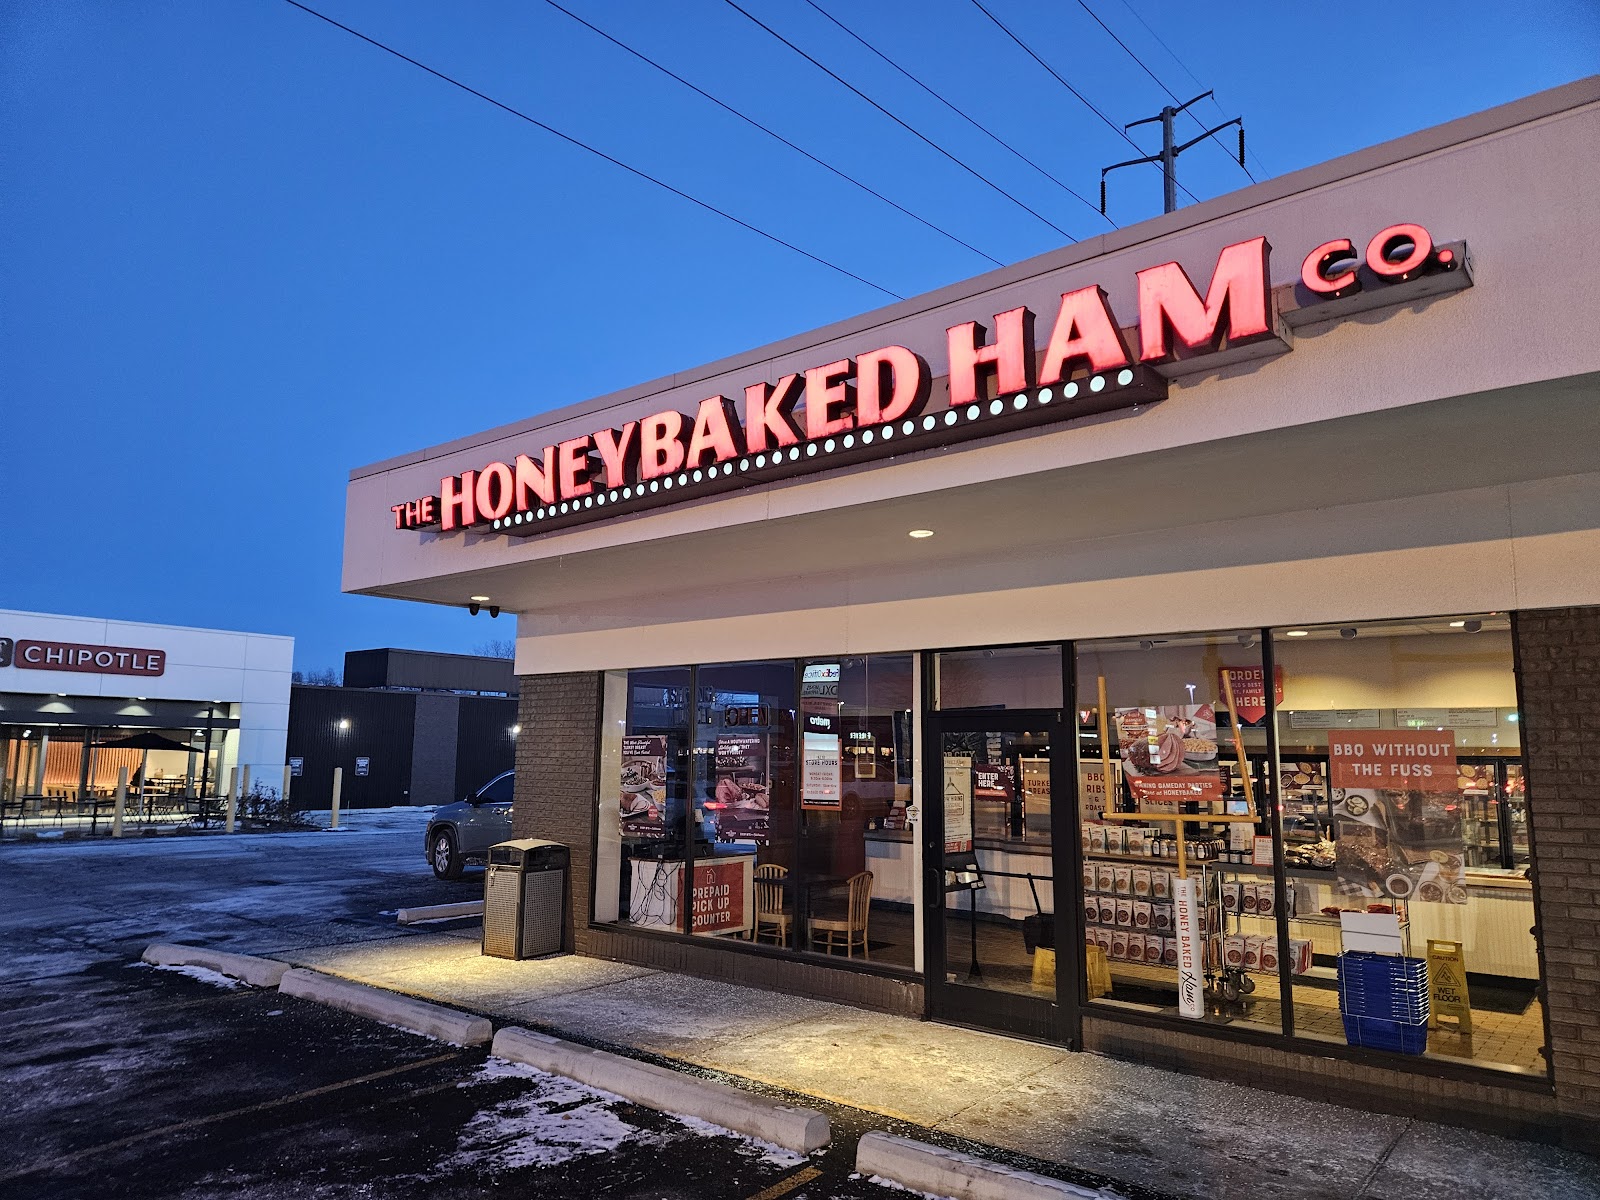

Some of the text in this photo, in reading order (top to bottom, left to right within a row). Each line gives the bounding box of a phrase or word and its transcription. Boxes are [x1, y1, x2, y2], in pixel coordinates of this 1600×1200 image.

[391, 223, 1456, 530] THE HONEYBAKED HAM CO.
[24, 646, 161, 671] CHIPOTLE
[1230, 670, 1263, 681] ORDE
[1236, 696, 1266, 707] HERE
[1333, 743, 1451, 757] BBQ WITHOUT
[977, 772, 999, 781] ENTER
[1087, 772, 1104, 782] BBQ
[1352, 763, 1433, 777] THE FUSS
[1027, 779, 1050, 787] TURKE
[1028, 787, 1051, 795] BREAS
[692, 884, 730, 899] PREPAID
[692, 897, 730, 913] PICK UP
[691, 911, 731, 927] COUNTER
[1179, 900, 1190, 933] HONEY
[1181, 936, 1192, 969] BAKED
[1437, 986, 1456, 995] WET
[1433, 993, 1461, 1003] FLOOR
